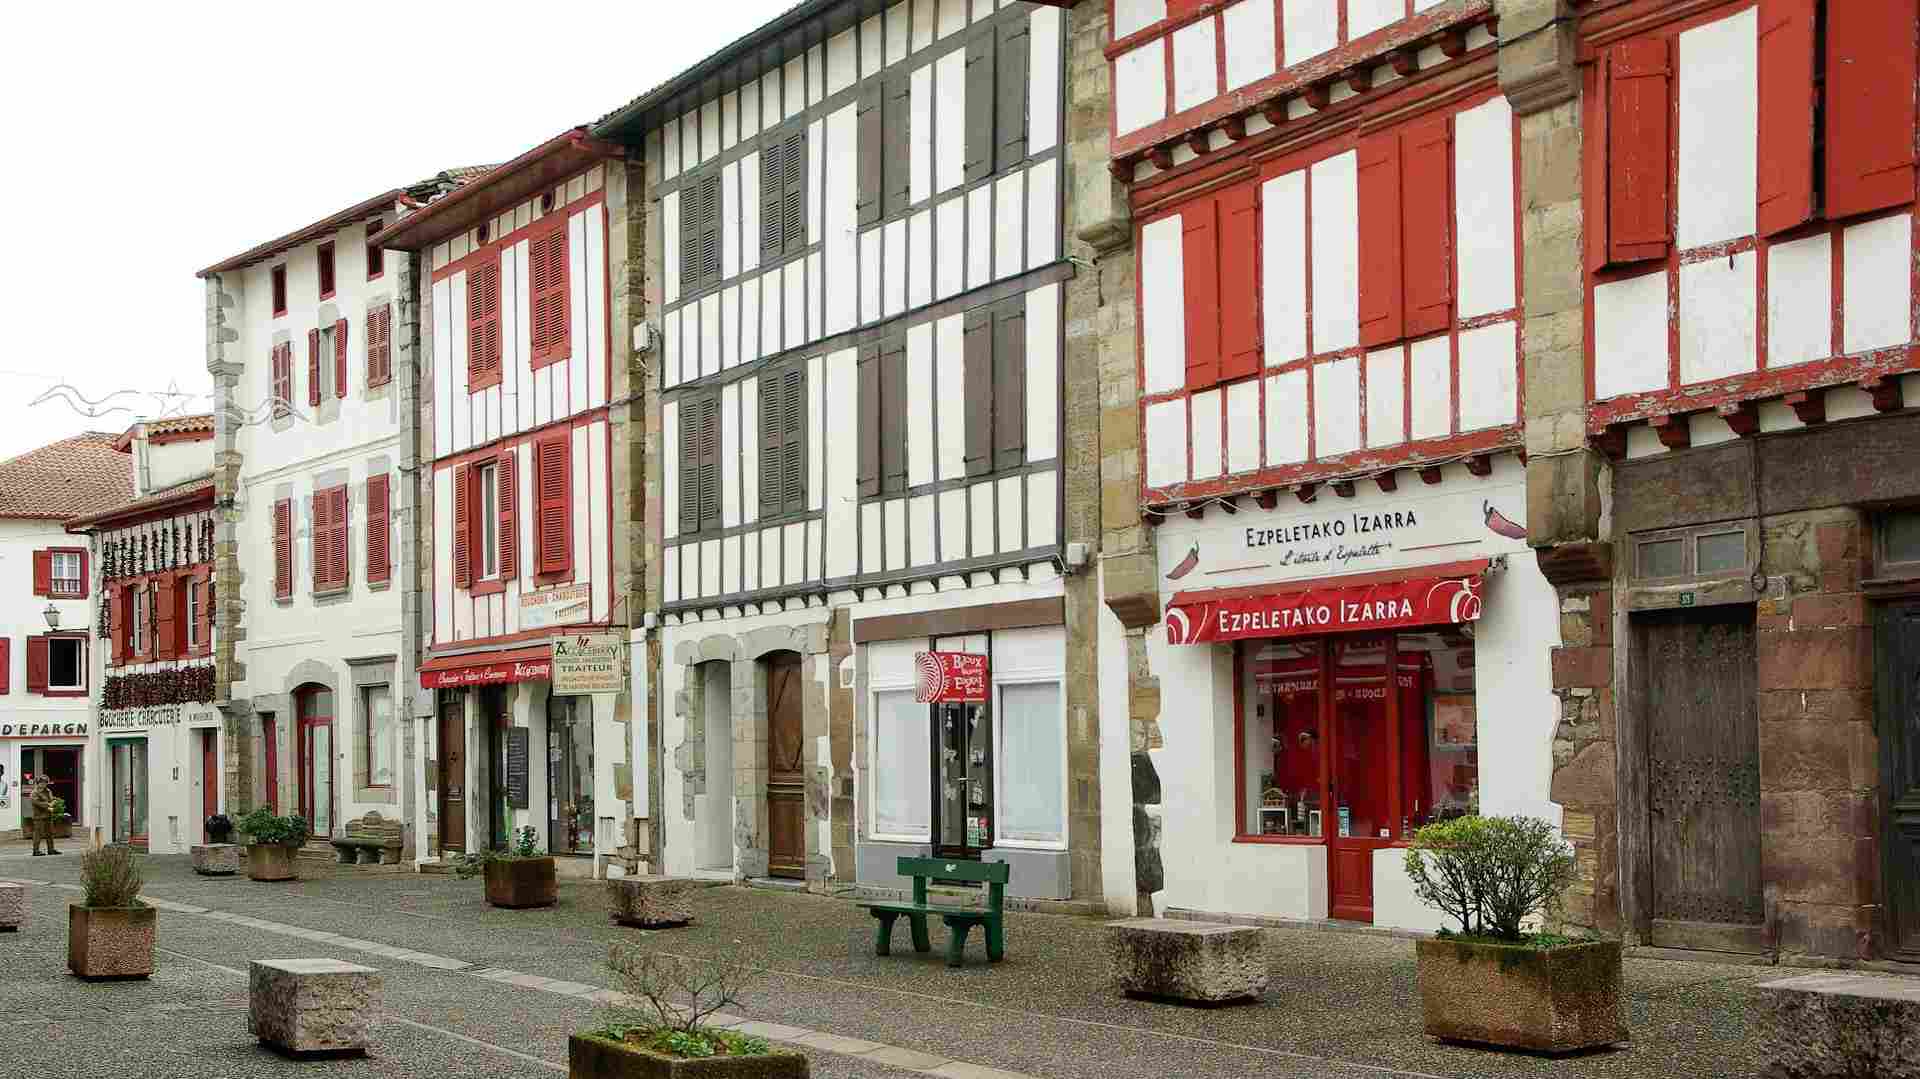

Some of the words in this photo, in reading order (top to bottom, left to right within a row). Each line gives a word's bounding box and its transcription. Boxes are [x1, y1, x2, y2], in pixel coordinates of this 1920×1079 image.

[1246, 520, 1345, 547] EZPELETAKO
[1353, 511, 1417, 533] IZARRA
[1219, 605, 1331, 633] EZPELETAKO
[1340, 598, 1413, 624] IZARRA
[100, 710, 135, 728] BOUCHERIE
